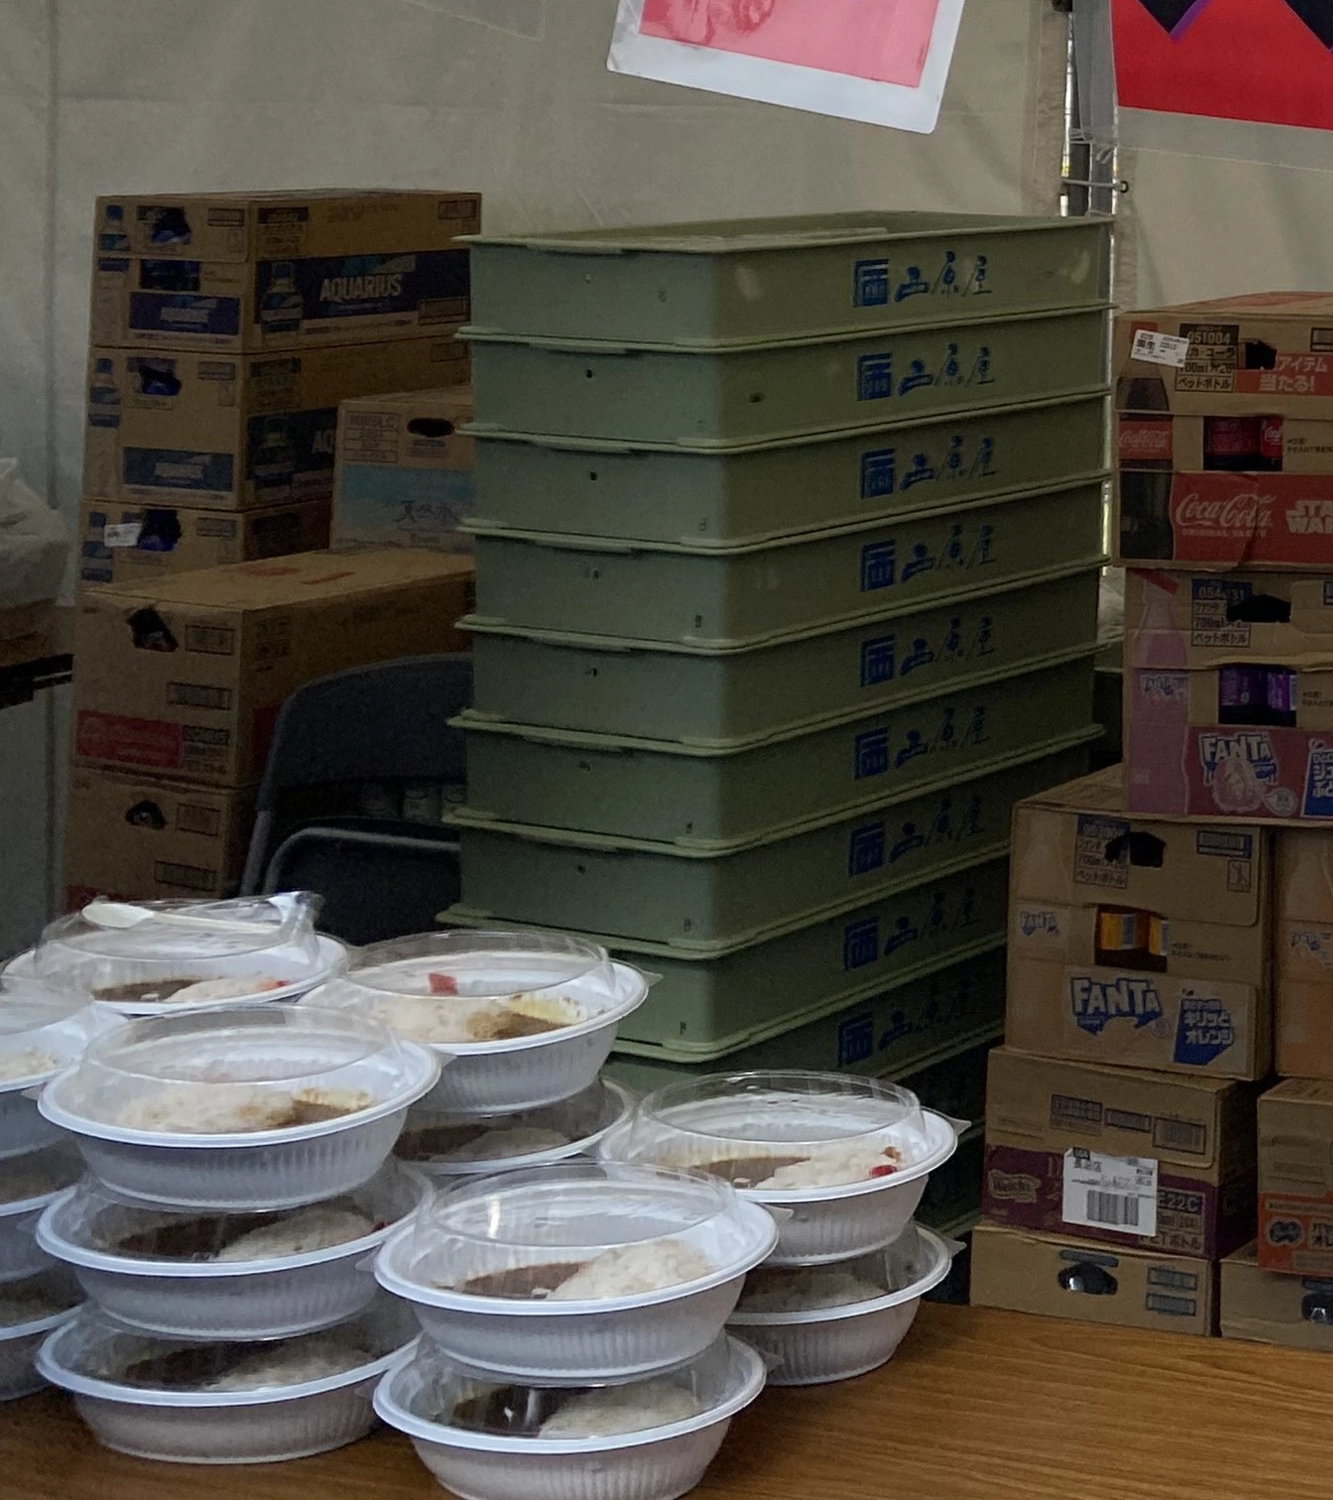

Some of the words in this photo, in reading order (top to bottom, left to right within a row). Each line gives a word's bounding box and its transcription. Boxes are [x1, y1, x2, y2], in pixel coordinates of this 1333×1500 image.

[320, 274, 402, 303] AQUARIUS
[1178, 378, 1231, 390] ペットボトル
[1175, 492, 1277, 528] Coca-Cola
[1201, 733, 1273, 763] FANTA
[1071, 977, 1163, 1017] FANTA
